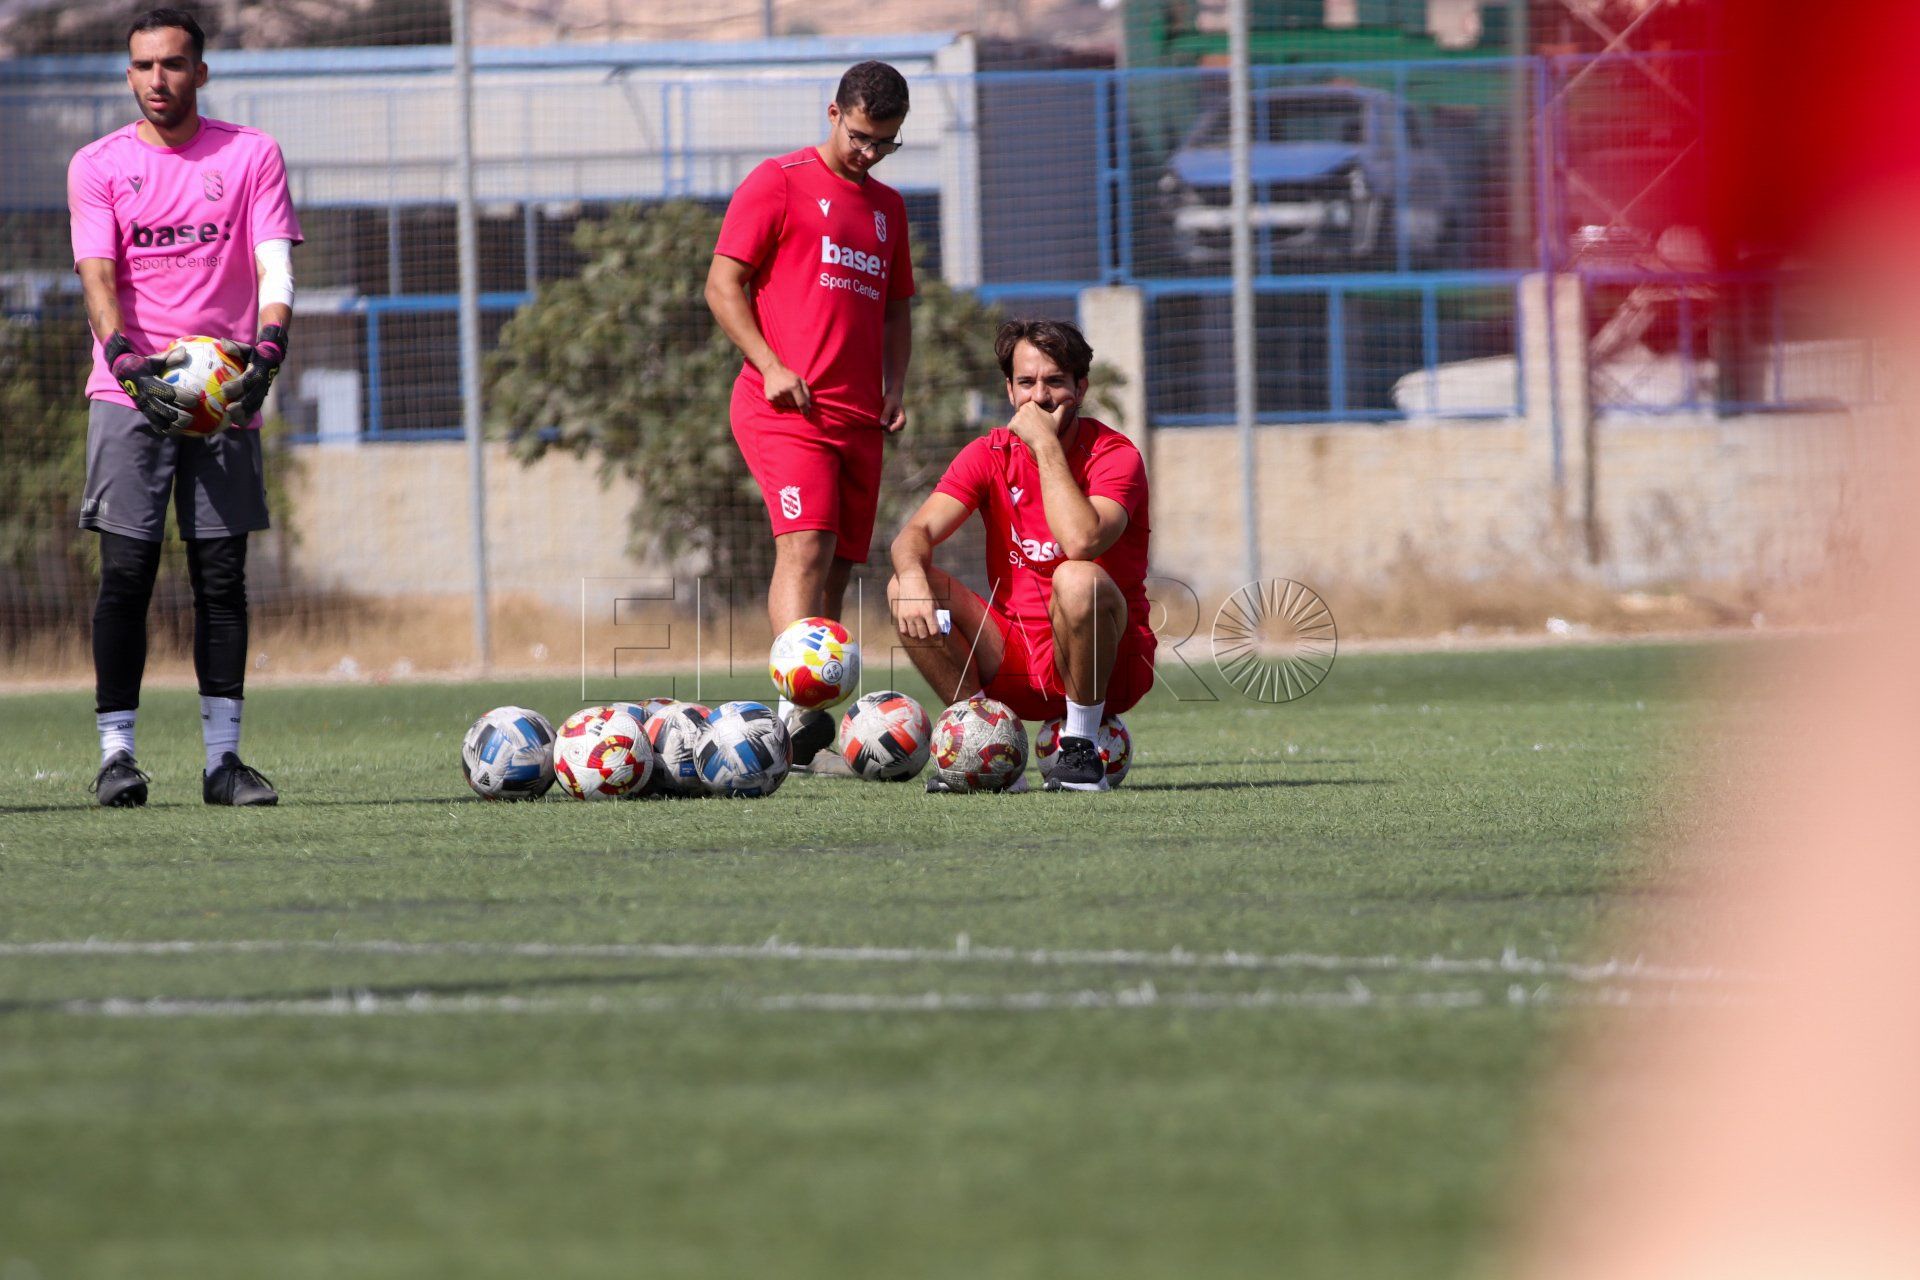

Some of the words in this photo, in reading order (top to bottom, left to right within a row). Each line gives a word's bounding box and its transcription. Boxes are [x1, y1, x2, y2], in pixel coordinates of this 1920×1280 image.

[132, 257, 171, 271] Sport
[175, 254, 224, 269] Center
[821, 235, 887, 279] base:
[819, 272, 852, 290] Sport
[853, 279, 881, 300] Center
